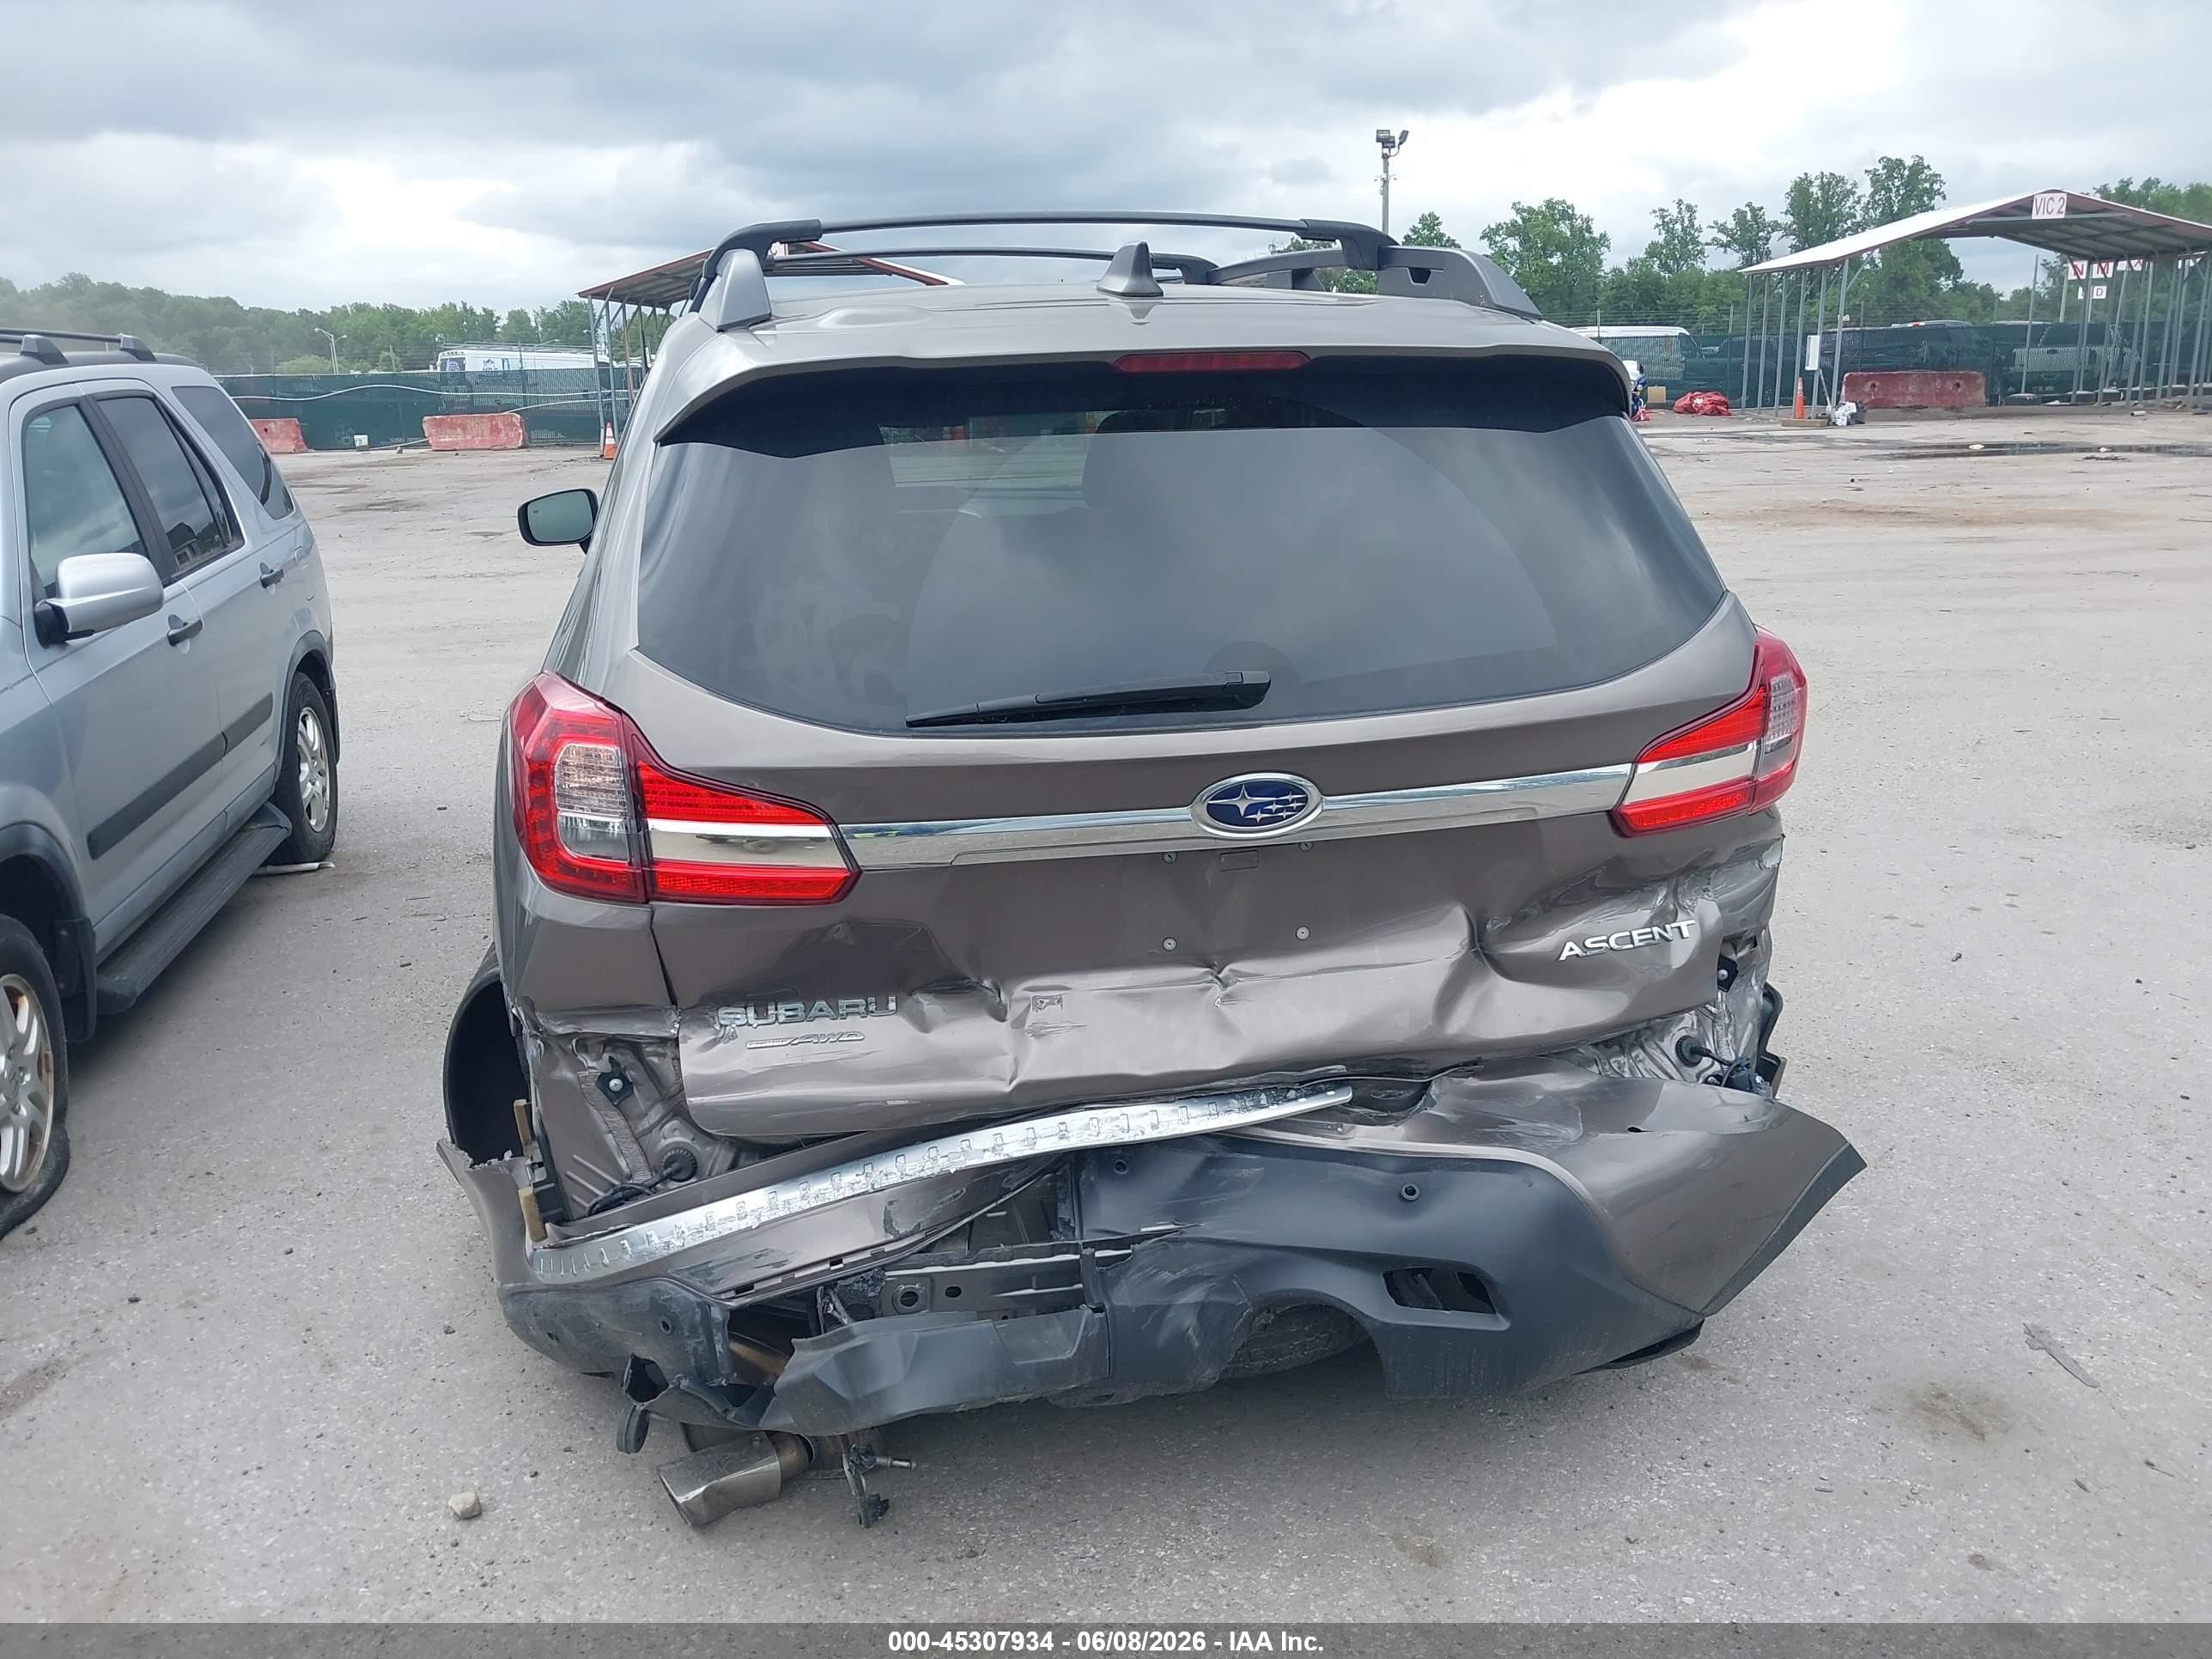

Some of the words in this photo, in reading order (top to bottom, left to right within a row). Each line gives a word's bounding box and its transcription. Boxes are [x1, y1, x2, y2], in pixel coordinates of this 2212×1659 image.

[2034, 197, 2055, 216] VIC
[2057, 197, 2065, 215] 2
[2096, 288, 2103, 296] D
[1557, 919, 1696, 963] ASCENT
[716, 995, 897, 1028] SUBARU
[790, 1030, 865, 1046] AWD
